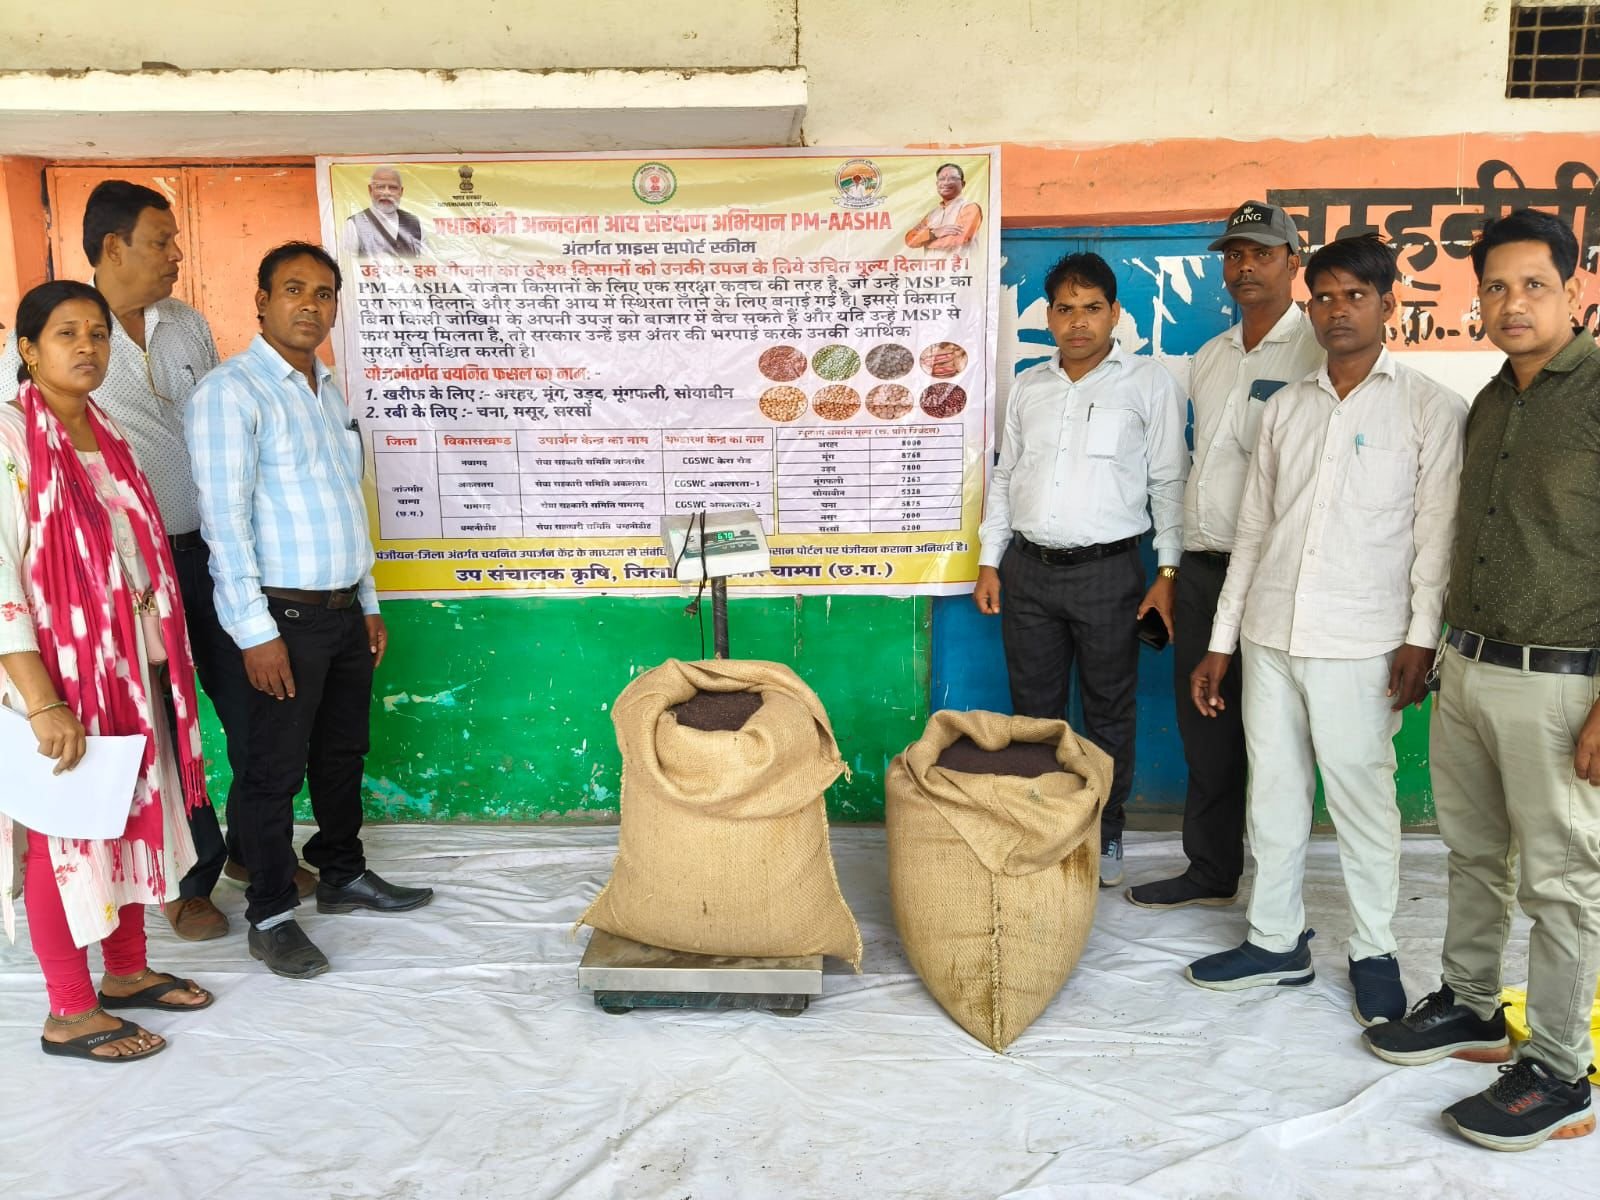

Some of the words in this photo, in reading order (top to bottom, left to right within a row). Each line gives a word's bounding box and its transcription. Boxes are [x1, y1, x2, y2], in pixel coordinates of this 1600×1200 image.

[433, 211, 516, 236] प्रधानमंत्री
[522, 215, 599, 234] अन्नदाता
[604, 215, 640, 232] आय
[643, 210, 707, 232] संरक्षण
[712, 208, 787, 232] अभियान
[791, 212, 892, 231] PM-AASHA
[1232, 214, 1262, 226] KING
[562, 240, 611, 256] अंतर्गत
[615, 241, 658, 256] प्राइस
[659, 239, 706, 254] सपोर्ट
[709, 238, 757, 254] स्कीम
[414, 264, 438, 279] इस
[442, 261, 493, 277] योजना
[498, 264, 519, 277] का
[571, 258, 630, 276] किसानों
[634, 258, 656, 276] को
[661, 258, 704, 276] उनकी
[710, 262, 748, 275] उपज
[752, 257, 769, 274] के
[772, 256, 805, 274] लिये
[808, 256, 850, 273] उचित
[856, 259, 889, 276] मूल्य
[894, 256, 946, 272] दिलाना
[358, 282, 462, 294] PM-AASHA
[466, 279, 516, 294] योजना
[520, 278, 580, 294] किसानों
[585, 278, 602, 293] के
[606, 278, 640, 296] लिए
[644, 280, 670, 295] एक
[674, 280, 716, 297] सुरक्षा
[720, 280, 762, 292] कवच
[767, 276, 790, 292] की
[794, 278, 822, 291] तरह
[872, 273, 900, 290] उन्हें
[905, 276, 944, 288] MSP
[950, 276, 972, 288] का
[388, 298, 424, 310] लाभ
[428, 294, 475, 310] दिलाने
[482, 296, 510, 310] और
[516, 295, 560, 310] उनकी
[566, 298, 598, 310] आय
[603, 294, 620, 310] में
[622, 294, 673, 310] स्थिरता
[678, 294, 710, 310] लाने
[714, 294, 730, 308] के
[734, 292, 766, 310] लिए
[814, 292, 838, 308] गई
[862, 291, 899, 307] इससे
[904, 289, 956, 305] किसान
[360, 310, 394, 326] बिना
[400, 310, 440, 326] किसी
[445, 310, 500, 326] जोखिम
[506, 312, 522, 326] के
[527, 311, 572, 326] अपनी
[576, 314, 612, 326] उपज
[618, 310, 640, 326] को
[644, 314, 690, 325] बाजार
[694, 310, 710, 324] में
[712, 310, 740, 324] बेच
[743, 309, 784, 324] सकते
[803, 308, 831, 323] और
[837, 308, 865, 322] यदि
[870, 306, 896, 324] उन्हें
[902, 309, 942, 321] MSP
[946, 307, 962, 320] से
[360, 330, 389, 342] कम
[393, 330, 428, 347] मूल्य
[434, 327, 483, 342] मिलता
[508, 328, 526, 342] तो
[530, 330, 580, 342] सरकार
[586, 326, 613, 342] उन्हें
[618, 330, 640, 344] इस
[646, 328, 680, 341] अंतर
[684, 326, 706, 341] की
[711, 326, 758, 342] भरपाई
[763, 324, 802, 340] करके
[807, 324, 850, 339] उनकी
[854, 322, 912, 338] आर्थिक
[361, 346, 403, 364] सुरक्षा
[475, 344, 516, 358] करती
[366, 388, 378, 400] 1.
[383, 386, 426, 400] खरीफ
[429, 386, 444, 400] के
[446, 386, 476, 402] लिए
[494, 388, 538, 402] अरहर,
[674, 384, 734, 400] सोयाबीन
[366, 406, 380, 418] 2.
[384, 404, 408, 418] रबी
[411, 404, 426, 418] के
[430, 403, 458, 420] लिए
[476, 406, 508, 420] चना,
[513, 406, 549, 420] मसूर,
[554, 402, 592, 417] सरसों
[386, 436, 417, 446] जिला
[538, 433, 578, 445] उपार्जन
[608, 436, 624, 445] का
[626, 436, 649, 445] नाम
[730, 436, 742, 444] का
[746, 435, 765, 444] नाम
[682, 456, 714, 464] CGSWC
[674, 480, 706, 488] CGSWC
[675, 500, 706, 508] CGSWC
[376, 550, 444, 560] पंजीयन-जिला
[448, 549, 478, 559] अंतर्गत
[481, 548, 517, 559] चयनित
[520, 548, 555, 559] उपार्जन
[558, 548, 574, 559] केंद्र
[576, 548, 586, 558] के
[590, 549, 626, 558] माध्यम
[627, 548, 638, 558] से
[797, 544, 822, 556] पोर्टल
[826, 546, 838, 555] पर
[842, 544, 878, 554] पंजीयन
[880, 545, 912, 554] कराना
[915, 542, 956, 553] अनिवार्य
[456, 568, 482, 582] उप
[488, 564, 564, 582] संचालक
[571, 563, 616, 584] कृषि,
[624, 563, 672, 579] जिला
[770, 565, 822, 578] चाम्पा
[828, 562, 893, 578] (छ.ग.)
